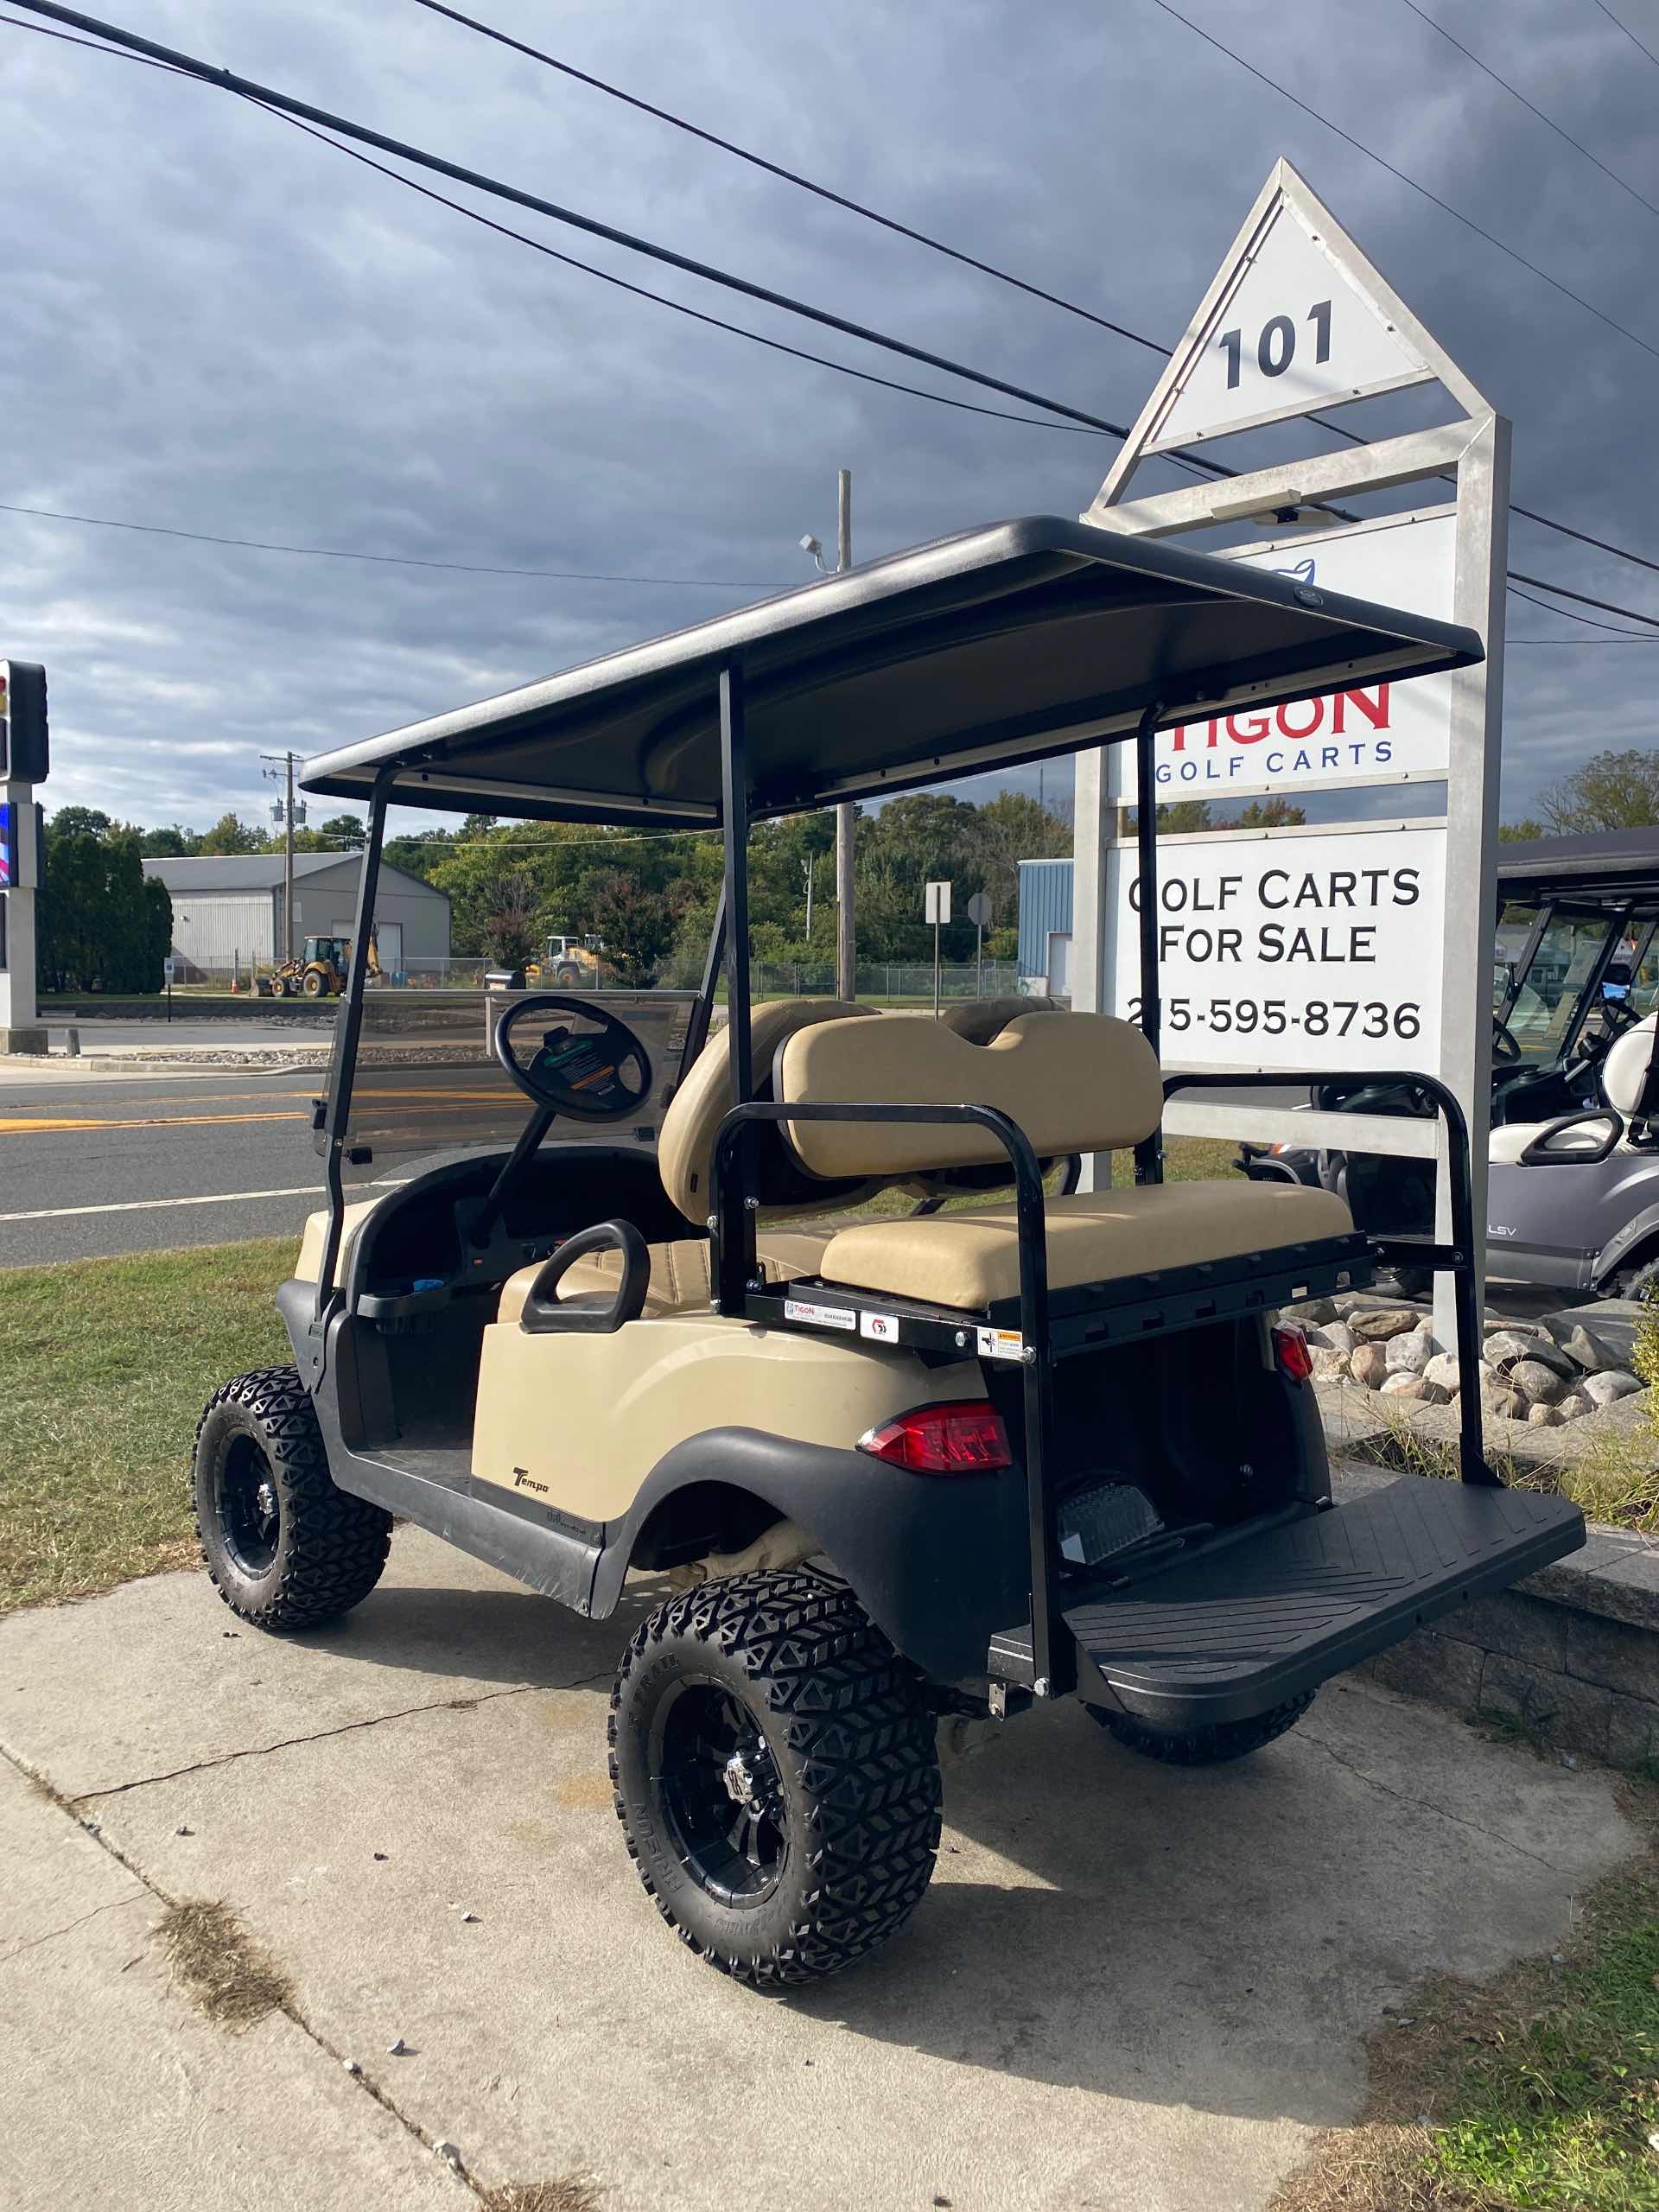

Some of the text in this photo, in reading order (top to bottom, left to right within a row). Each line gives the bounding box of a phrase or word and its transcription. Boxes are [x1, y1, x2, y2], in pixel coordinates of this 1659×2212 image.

[1218, 299, 1332, 390] 101
[1155, 741, 1393, 784] GOLF CARTS
[1258, 868, 1421, 909] CARTS
[1159, 922, 1376, 963] FOR SALE
[1127, 996, 1421, 1039] 25-595-8736
[1488, 1224, 1517, 1236] LSV
[794, 1304, 815, 1314] TIGON
[512, 1466, 550, 1493] Tempo
